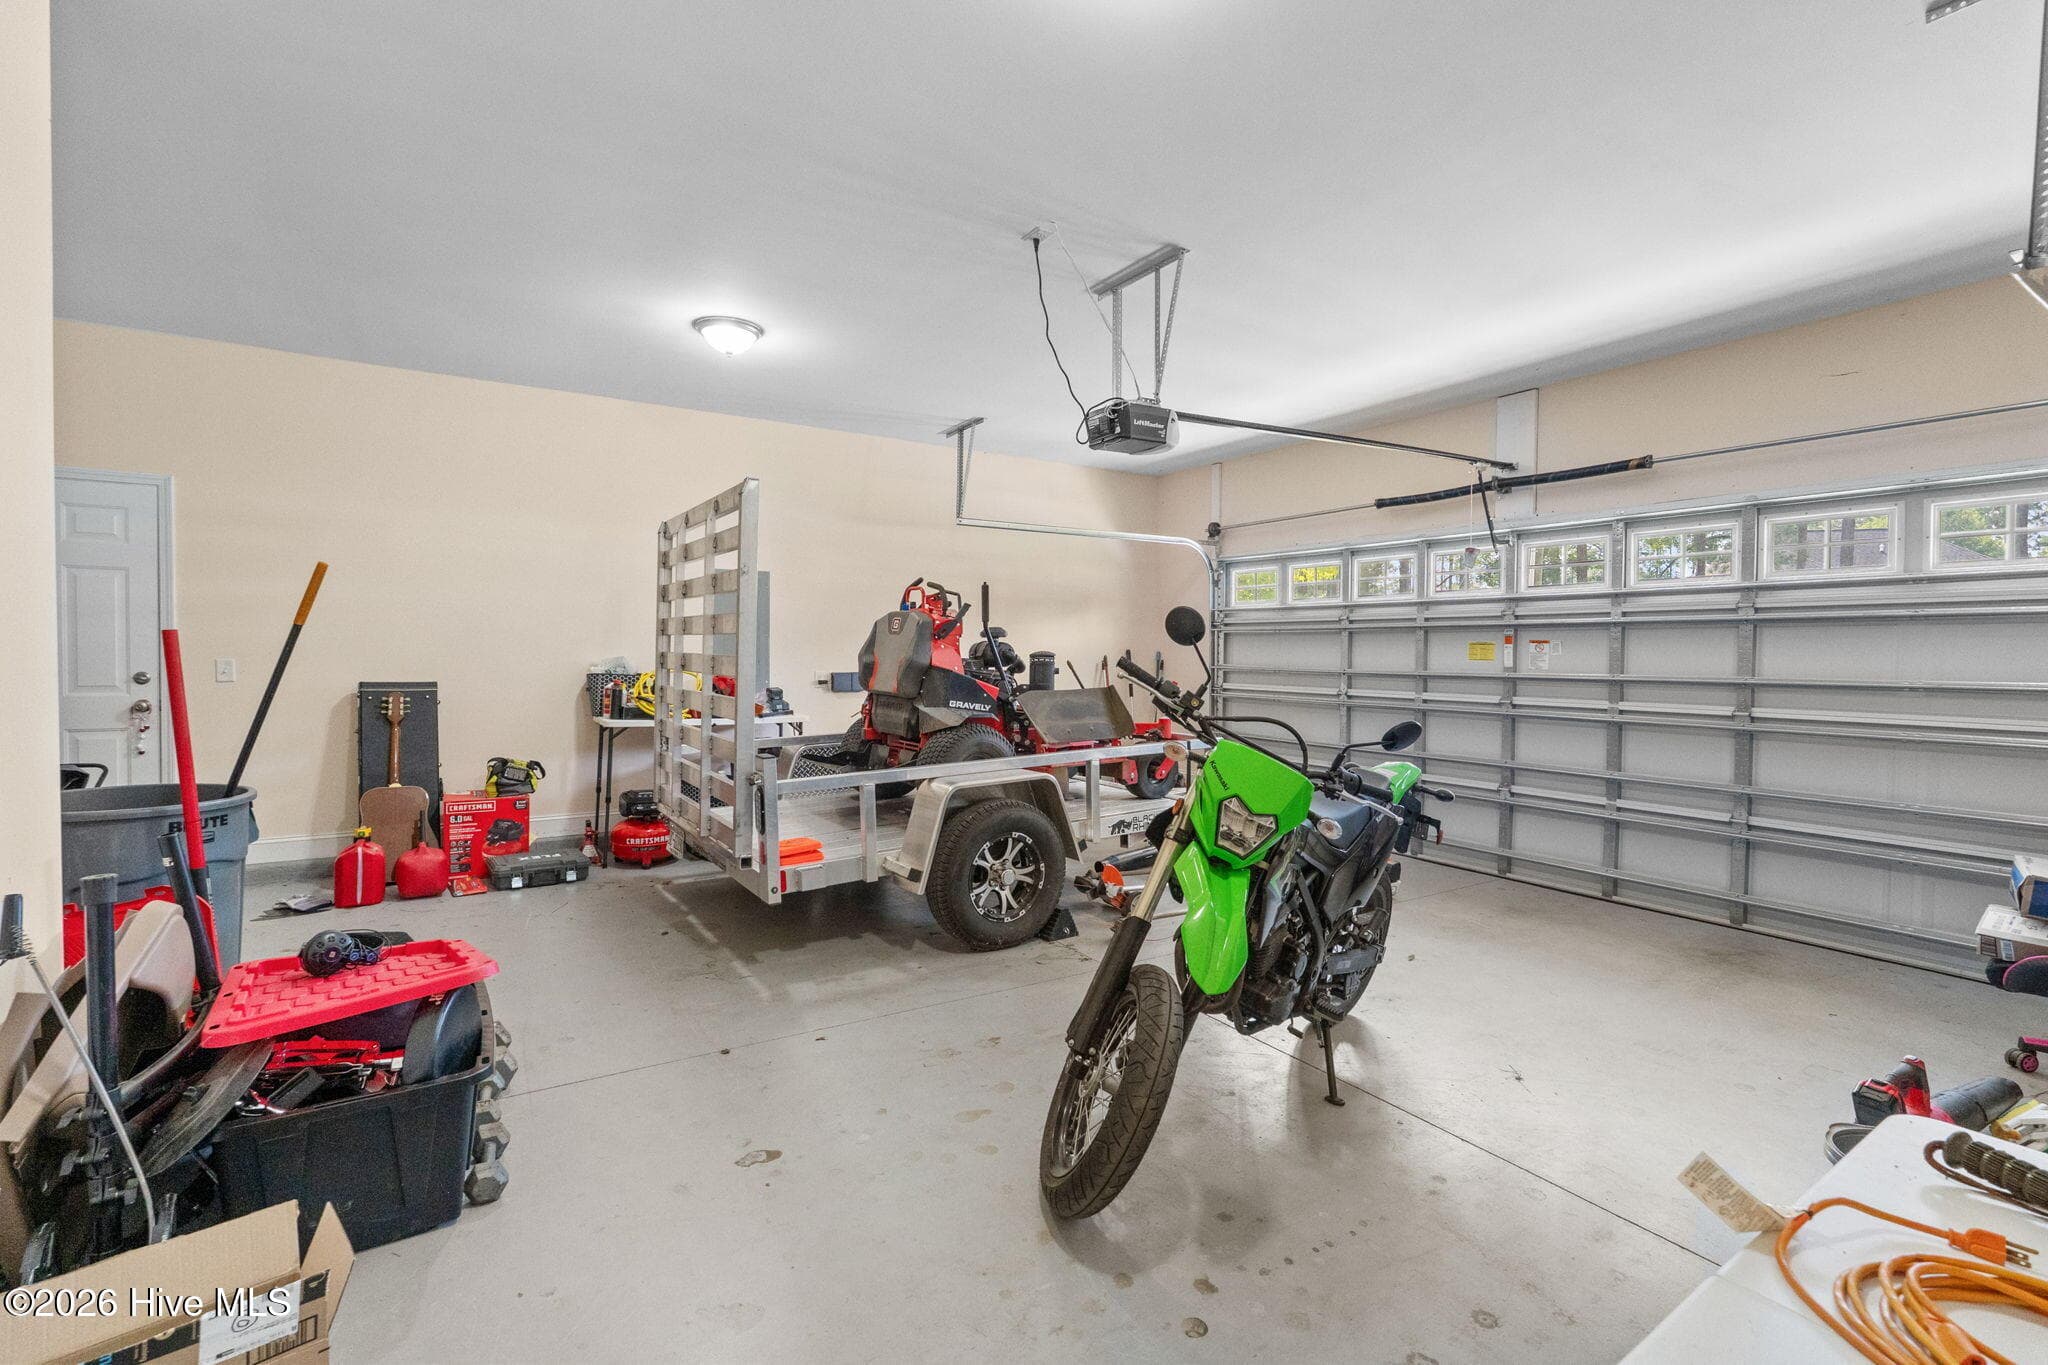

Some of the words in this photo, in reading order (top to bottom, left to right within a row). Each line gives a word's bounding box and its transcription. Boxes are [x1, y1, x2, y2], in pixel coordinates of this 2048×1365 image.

[1134, 419, 1164, 428] LiftMaster
[949, 700, 991, 711] GRAVELY
[1210, 760, 1229, 790] Kawasaki
[449, 803, 493, 812] CRAFTSMAN
[168, 814, 229, 833] BUTE
[1132, 813, 1154, 824] BLAC
